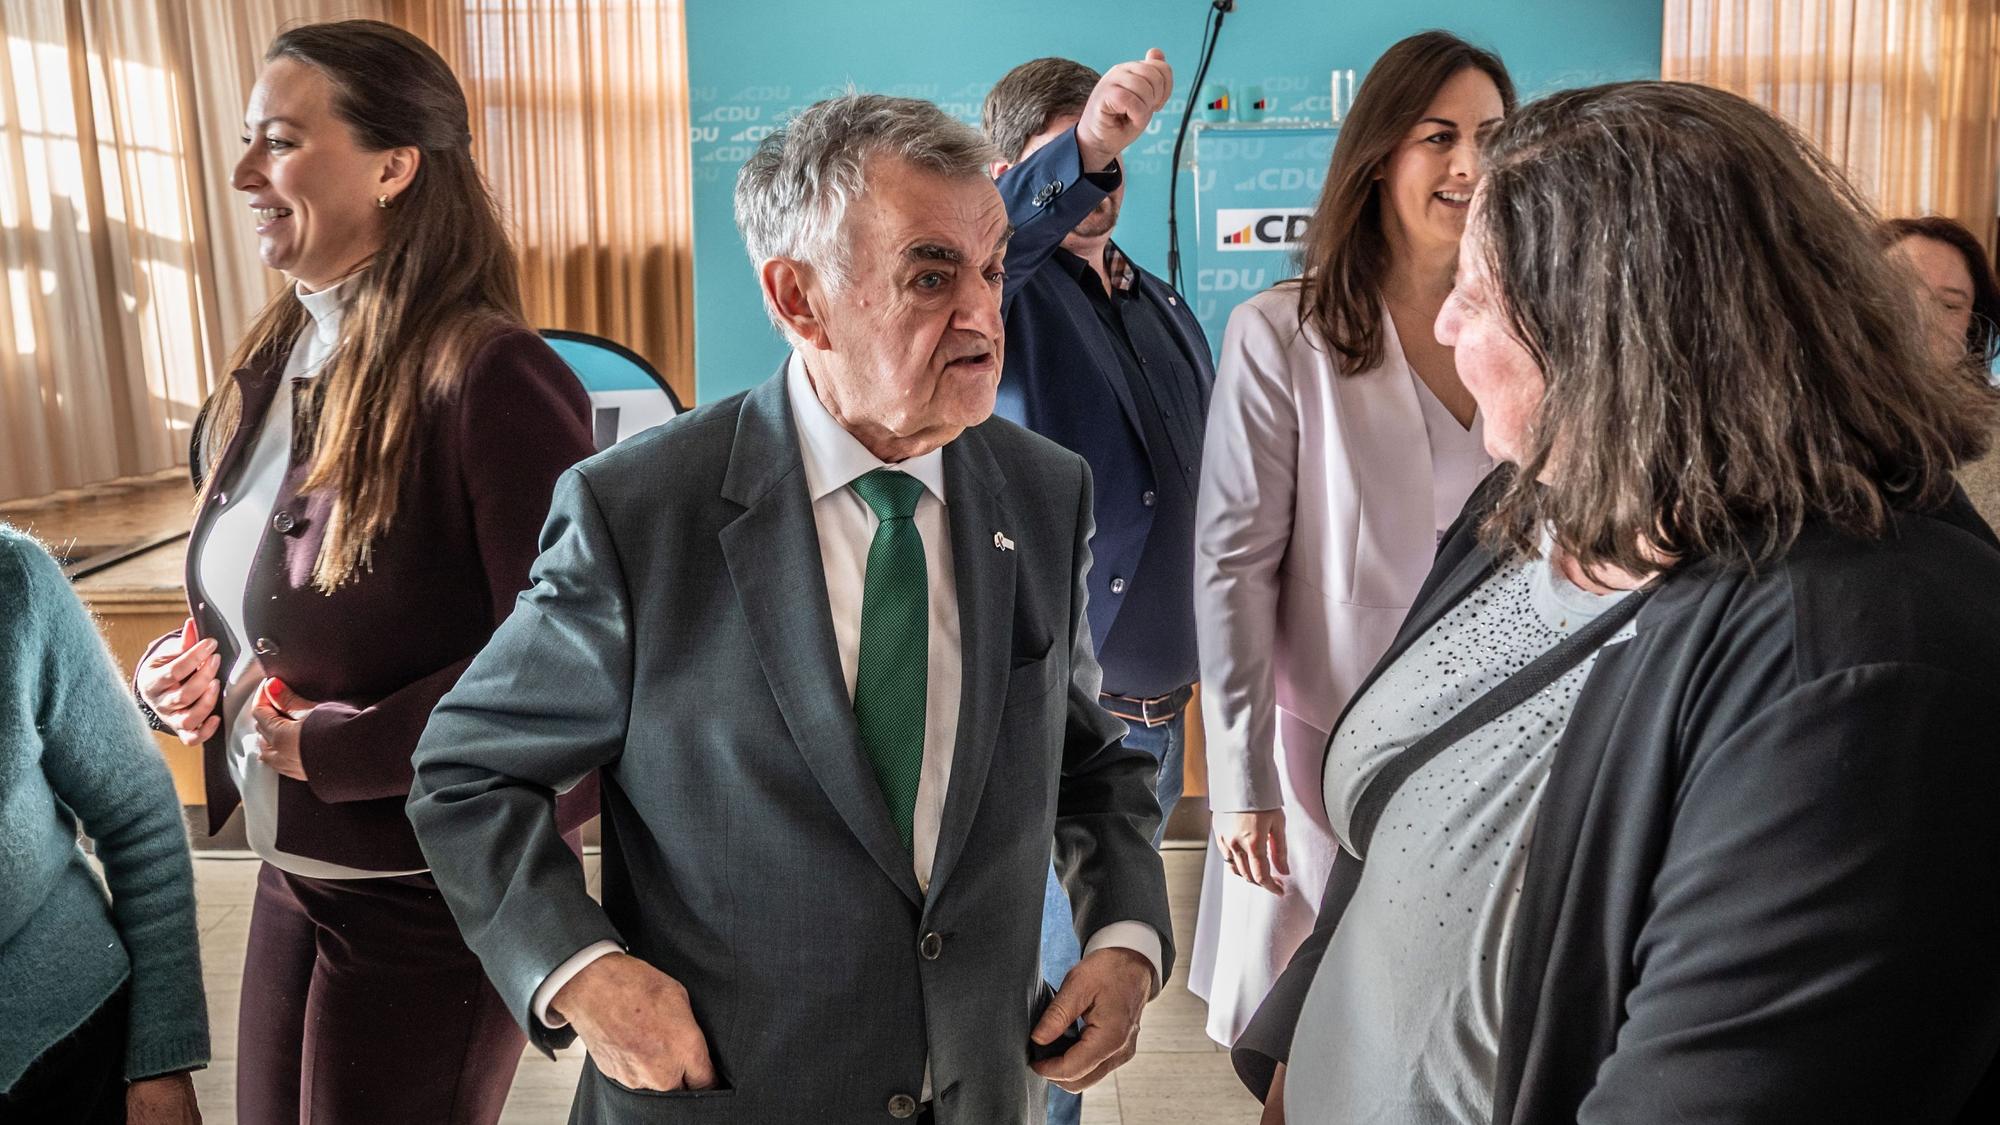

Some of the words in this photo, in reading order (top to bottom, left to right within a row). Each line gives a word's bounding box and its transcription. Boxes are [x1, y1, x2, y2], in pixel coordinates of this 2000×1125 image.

[714, 106, 761, 121] CDU
[690, 126, 720, 142] DU
[1255, 214, 1314, 243] CD
[1198, 268, 1265, 291] CDU
